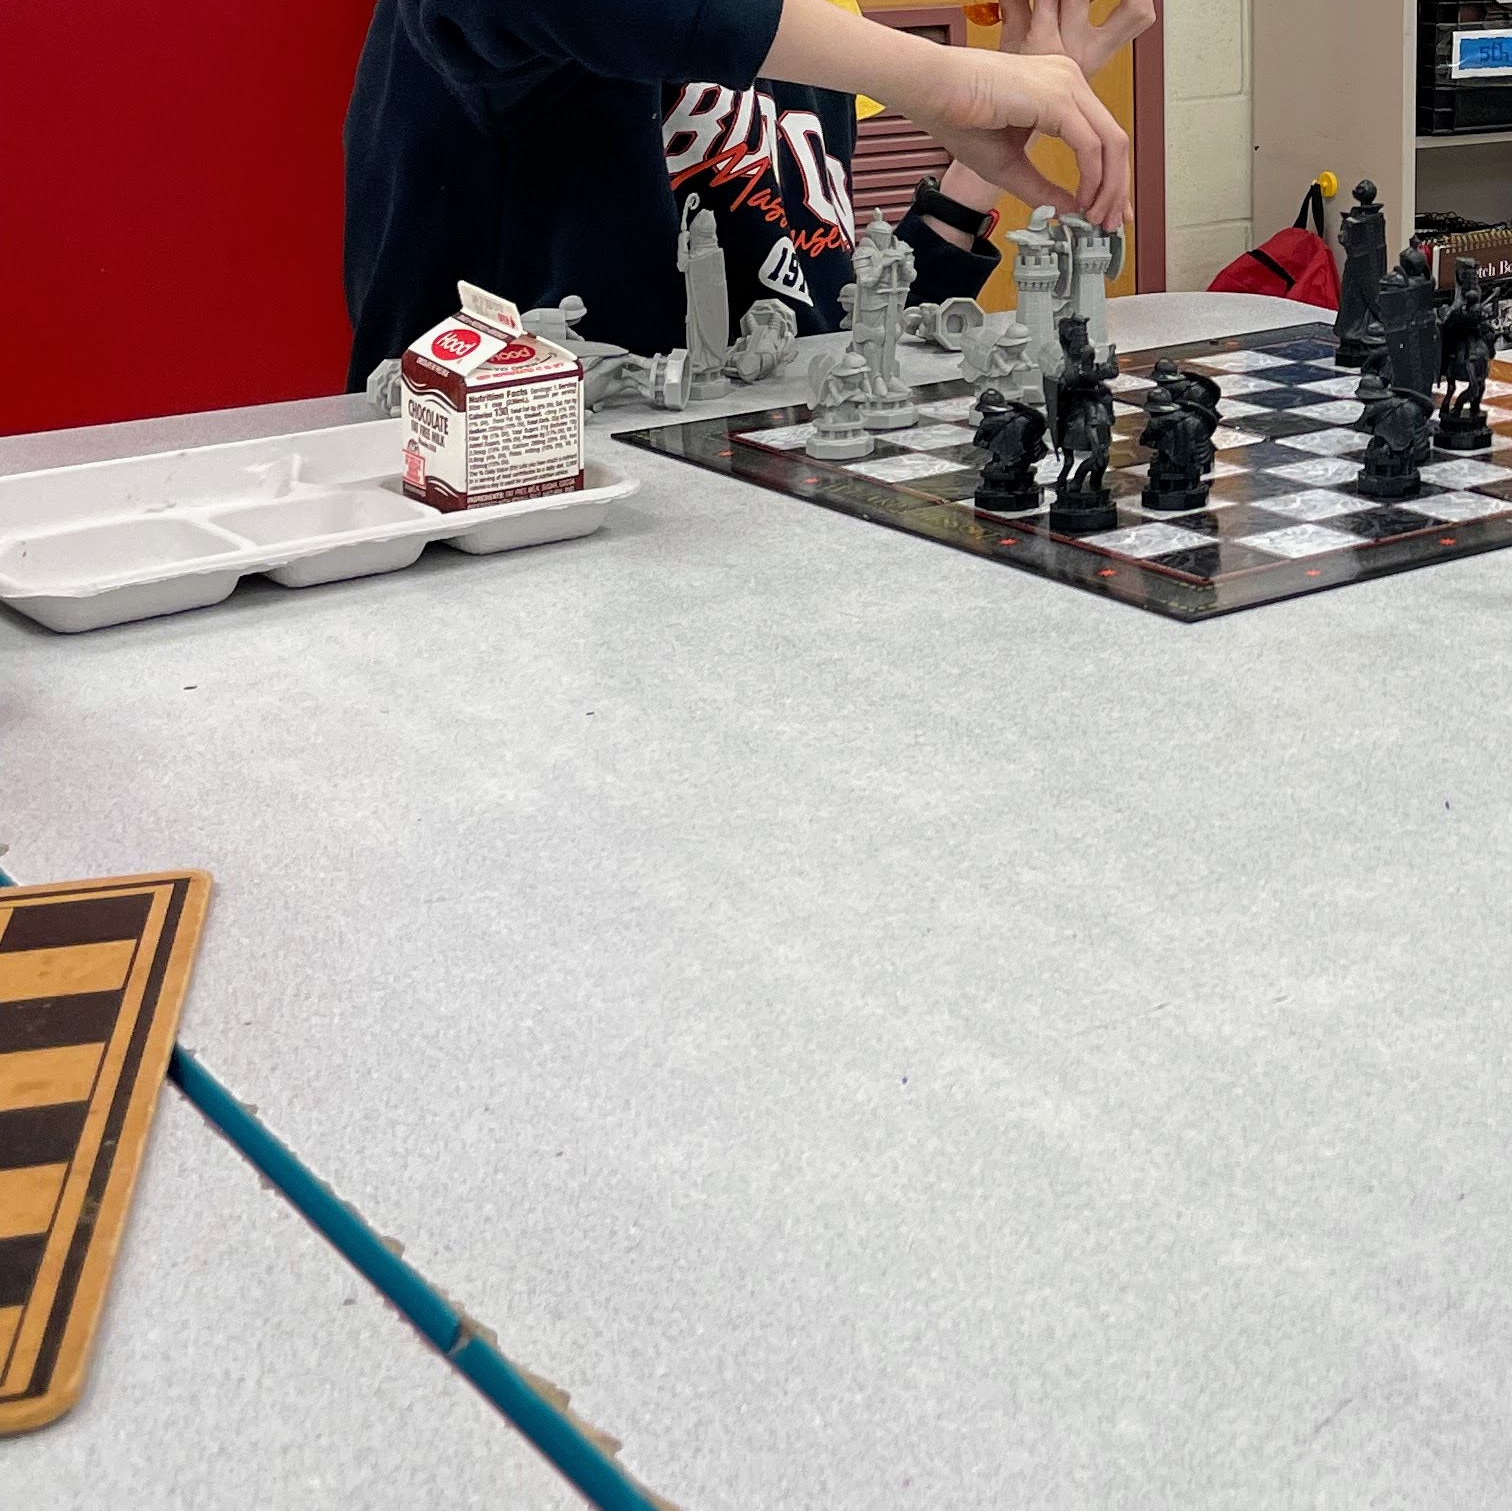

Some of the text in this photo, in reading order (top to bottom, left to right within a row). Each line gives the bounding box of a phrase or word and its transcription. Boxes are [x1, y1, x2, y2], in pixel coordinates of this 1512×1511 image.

[1479, 42, 1510, 63] 5th
[435, 331, 477, 356] Hood
[506, 389, 528, 398] Facts
[408, 398, 449, 435] CHOCOLATE
